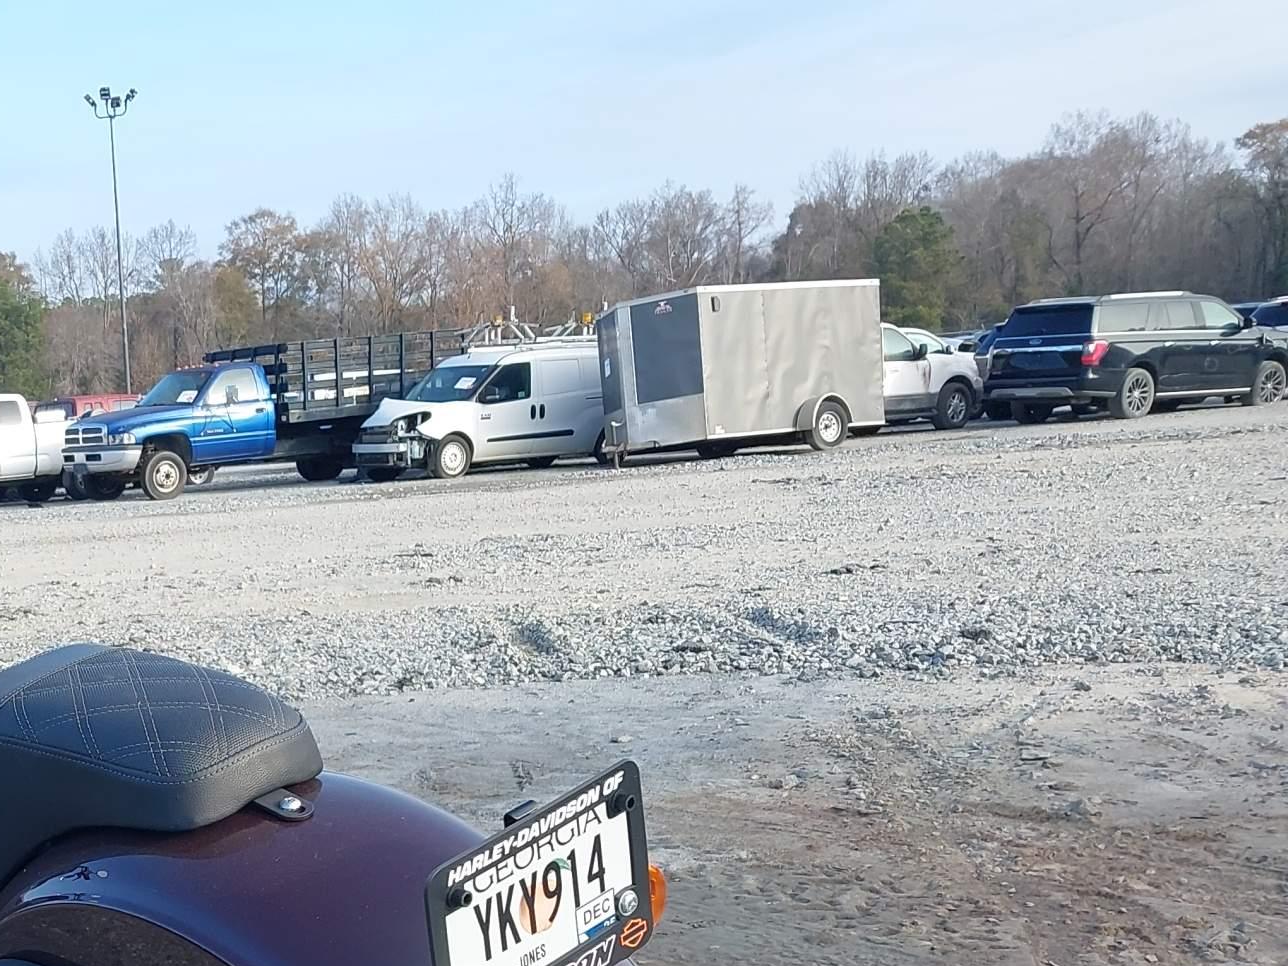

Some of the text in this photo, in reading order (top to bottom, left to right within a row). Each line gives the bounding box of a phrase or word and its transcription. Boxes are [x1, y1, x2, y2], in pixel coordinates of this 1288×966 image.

[448, 770, 624, 887] HARLEY-DAVIDSON OF
[473, 833, 606, 961] YKY914
[583, 898, 611, 926] DEC
